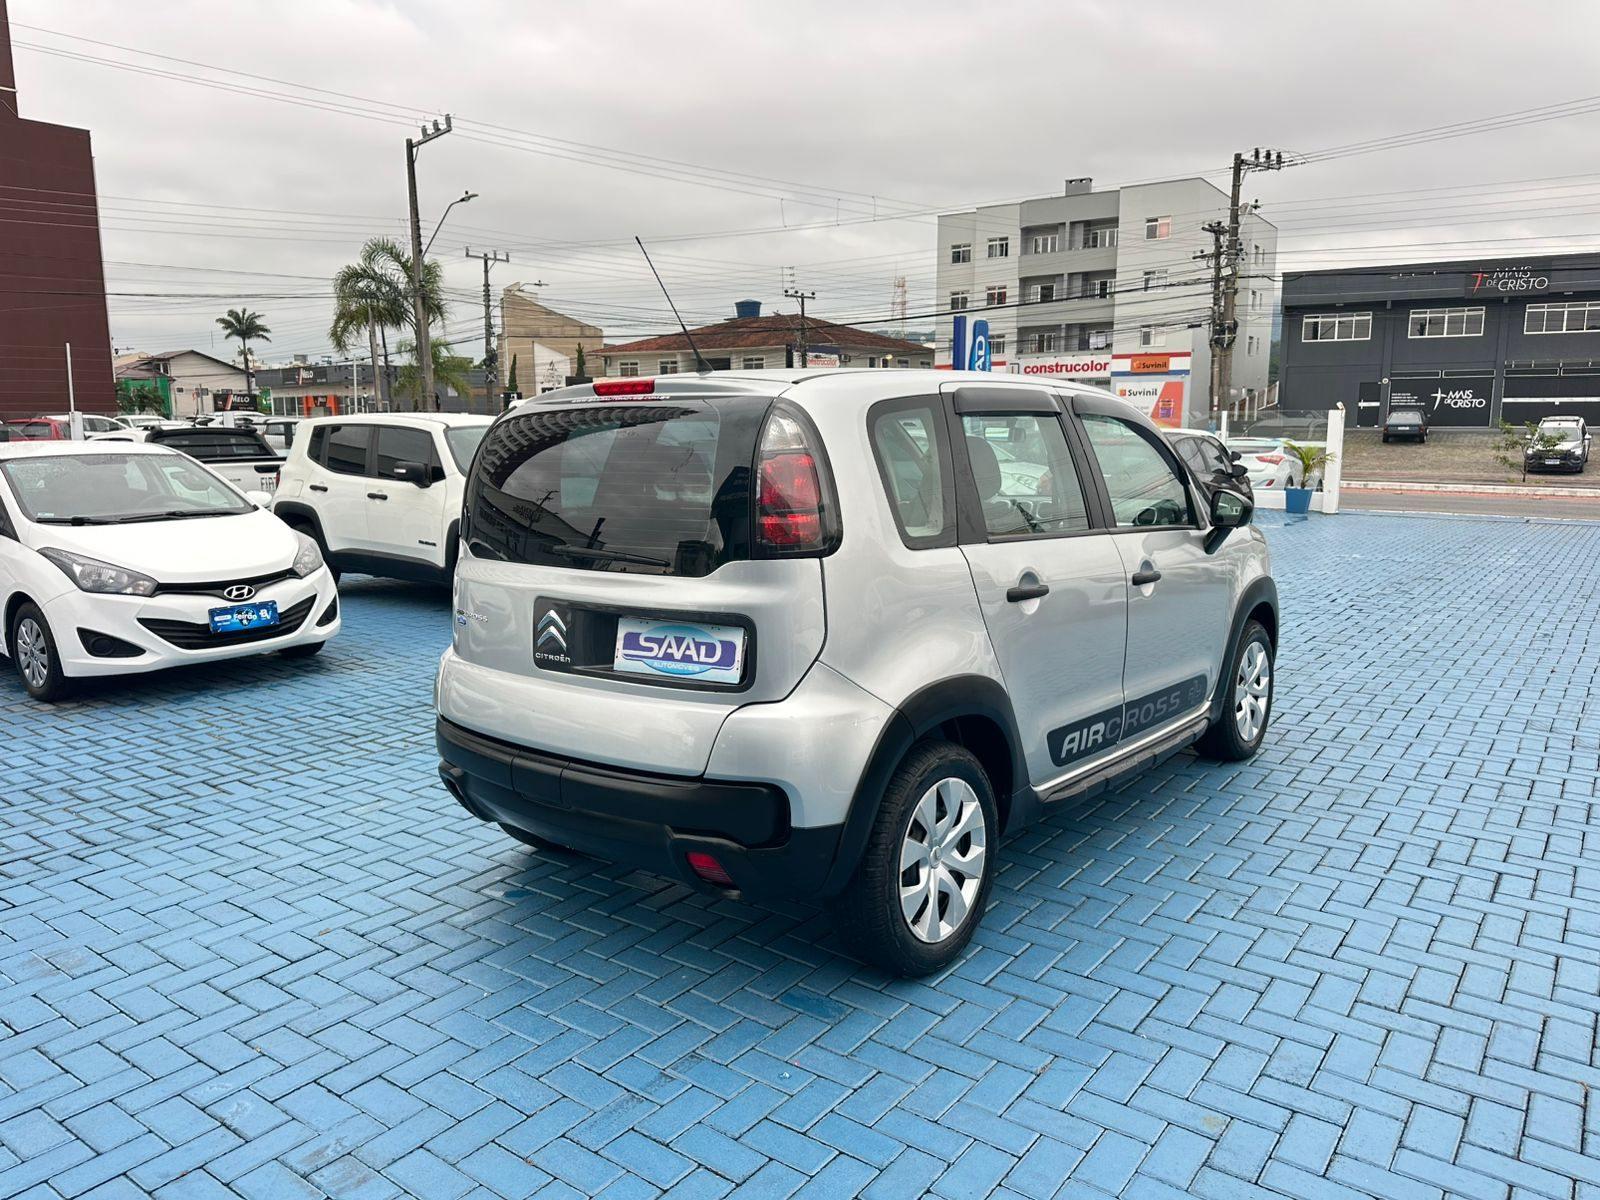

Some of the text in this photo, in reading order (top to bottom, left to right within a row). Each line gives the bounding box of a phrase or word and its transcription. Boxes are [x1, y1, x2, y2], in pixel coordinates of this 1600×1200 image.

[1497, 276, 1548, 291] CRISTO
[1023, 360, 1110, 374] construcolor
[1142, 361, 1167, 369] Suvinil
[1128, 388, 1158, 397] Suvinil
[1447, 389, 1473, 399] MAIS
[1450, 397, 1486, 408] CRISTO
[636, 634, 722, 664] SAAD
[1060, 691, 1181, 759] AIRCROSS
